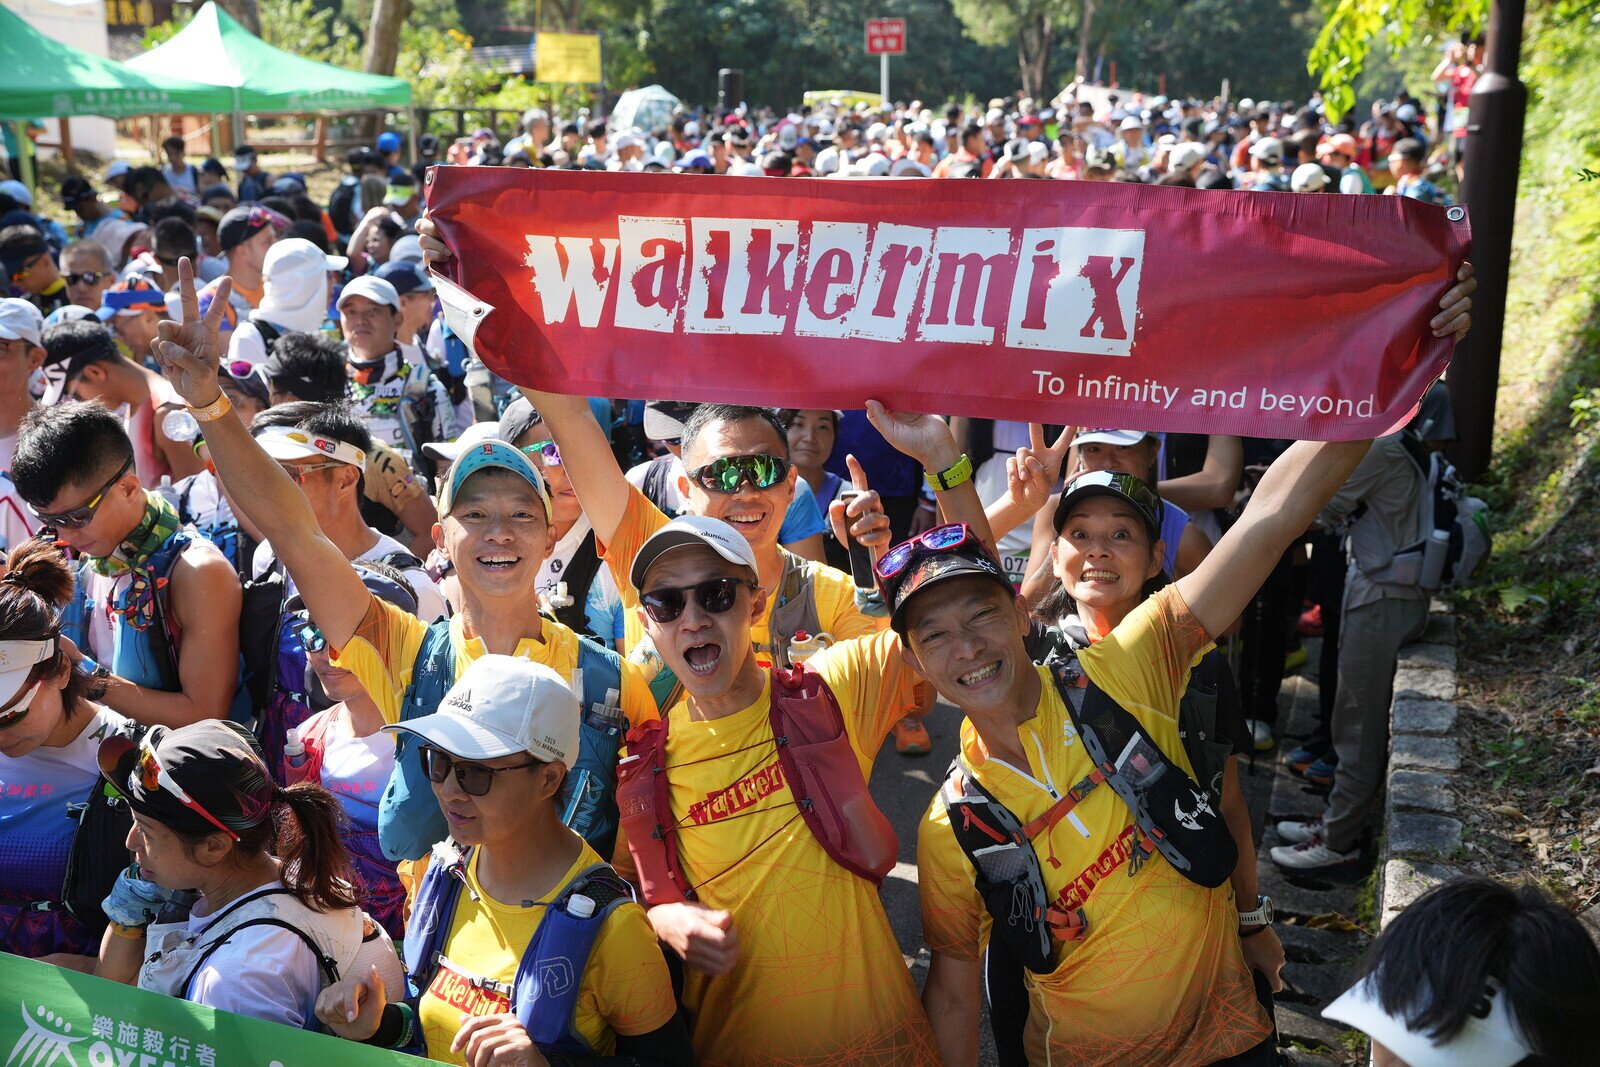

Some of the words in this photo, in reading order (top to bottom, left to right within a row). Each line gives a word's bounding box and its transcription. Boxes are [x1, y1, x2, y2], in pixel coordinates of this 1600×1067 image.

[522, 214, 1146, 357] walkermix
[1032, 369, 1065, 396] To
[1077, 373, 1179, 409] infinity
[1190, 386, 1247, 409] and
[1260, 387, 1375, 419] beyond
[1004, 556, 1029, 572] 07
[447, 698, 473, 712] adidas
[92, 1014, 217, 1067] 樂施毅行者
